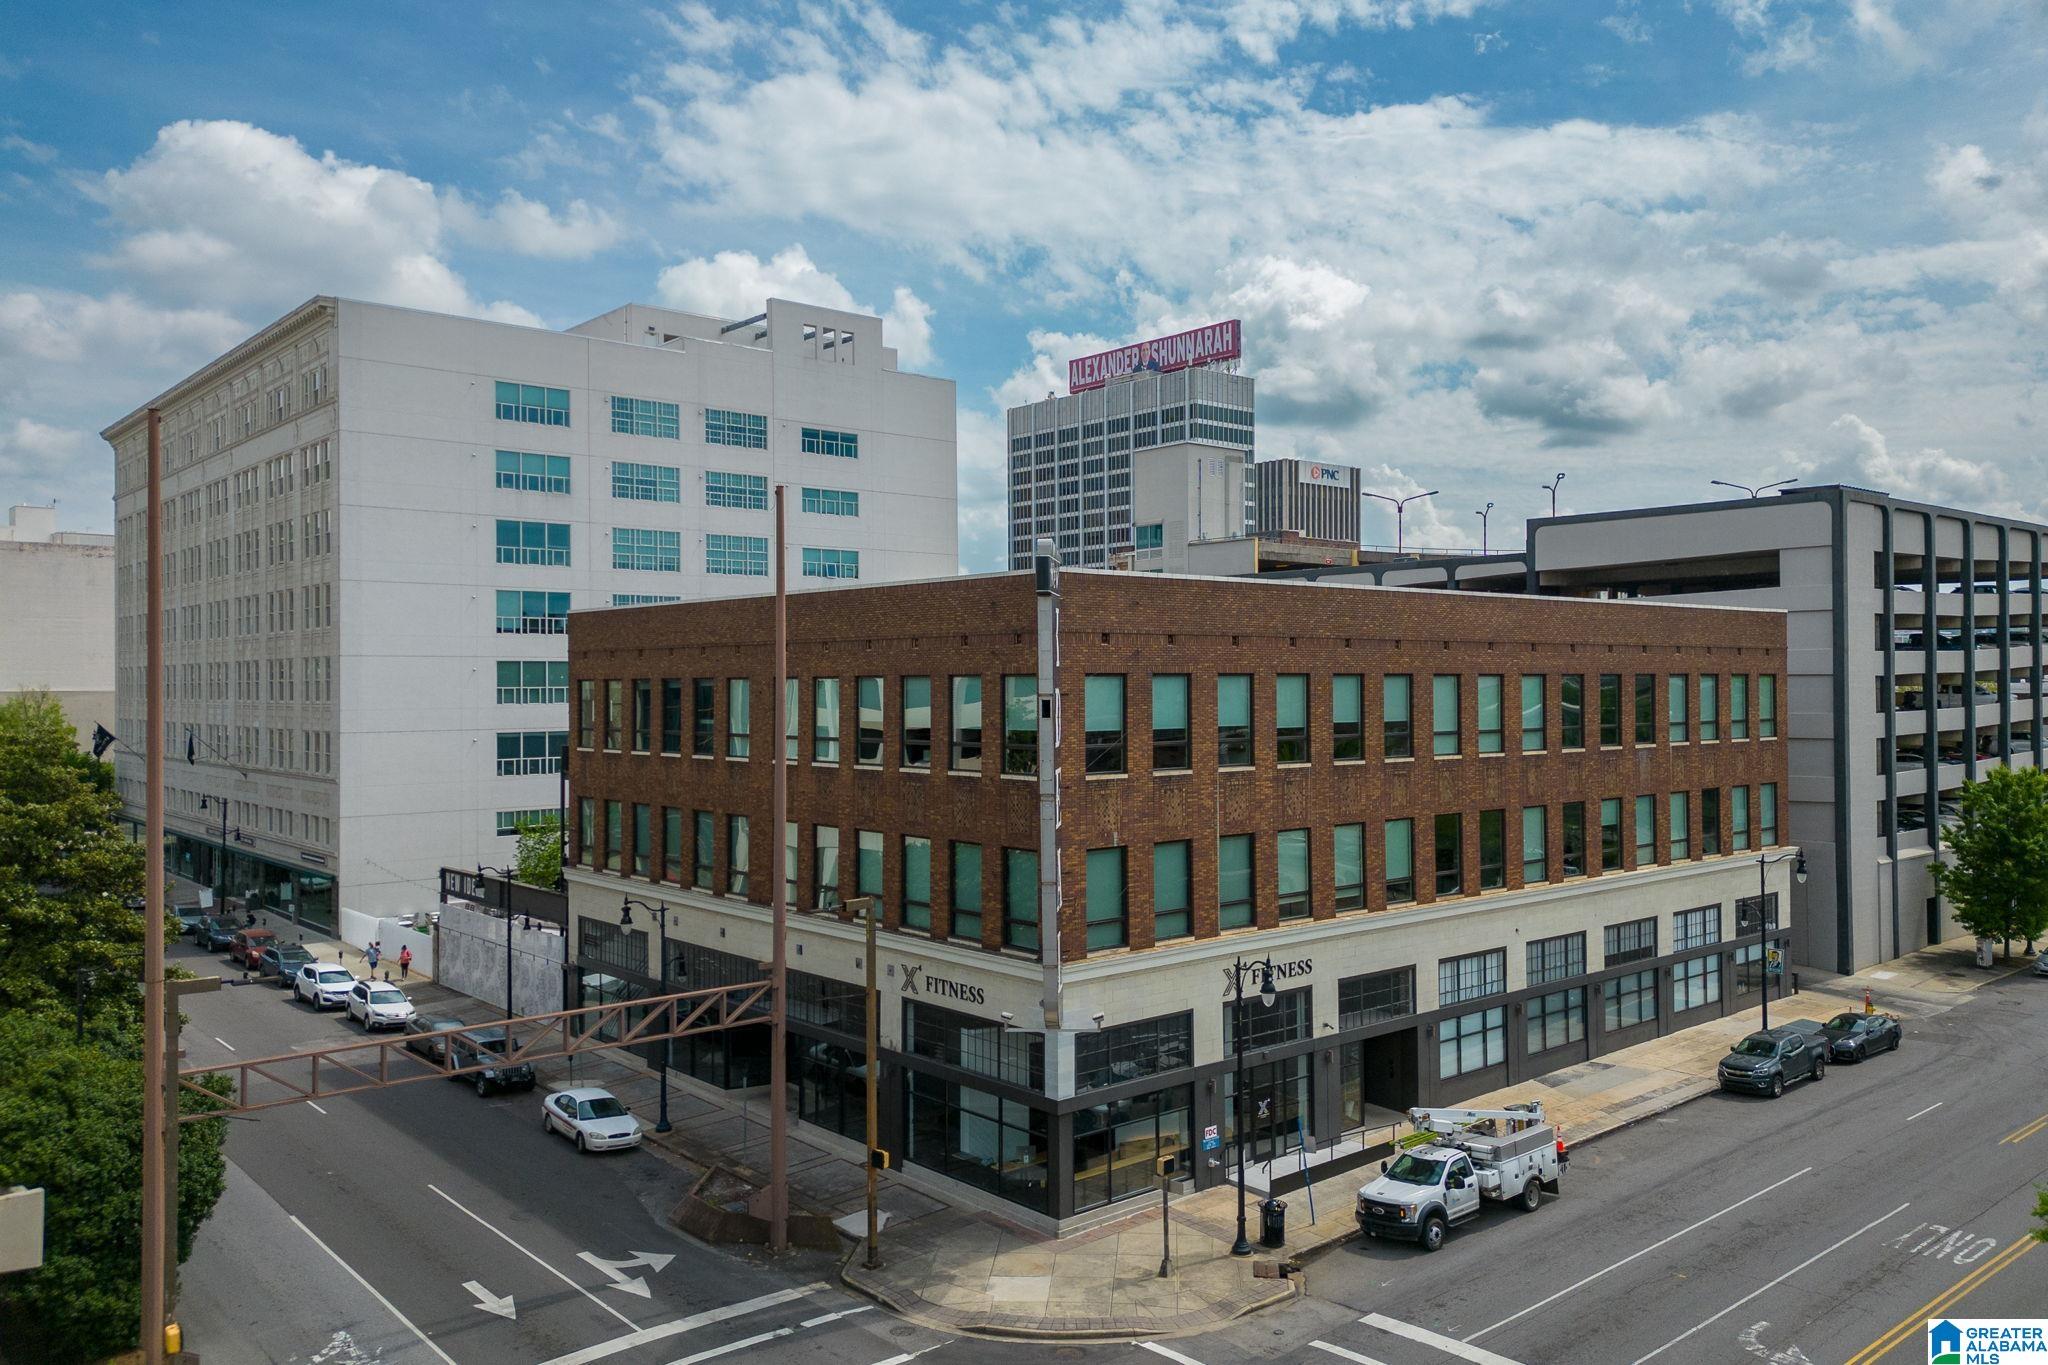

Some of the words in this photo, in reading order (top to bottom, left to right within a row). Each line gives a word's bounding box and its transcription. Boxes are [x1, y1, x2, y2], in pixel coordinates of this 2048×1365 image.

[1071, 349, 1139, 386] ALEXANDER
[1151, 323, 1232, 366] SHUNNARAH
[1321, 468, 1339, 481] PNC
[926, 975, 985, 1005] FITNESS
[1206, 1127, 1216, 1137] FDC
[1882, 1222, 1996, 1264] ONLY
